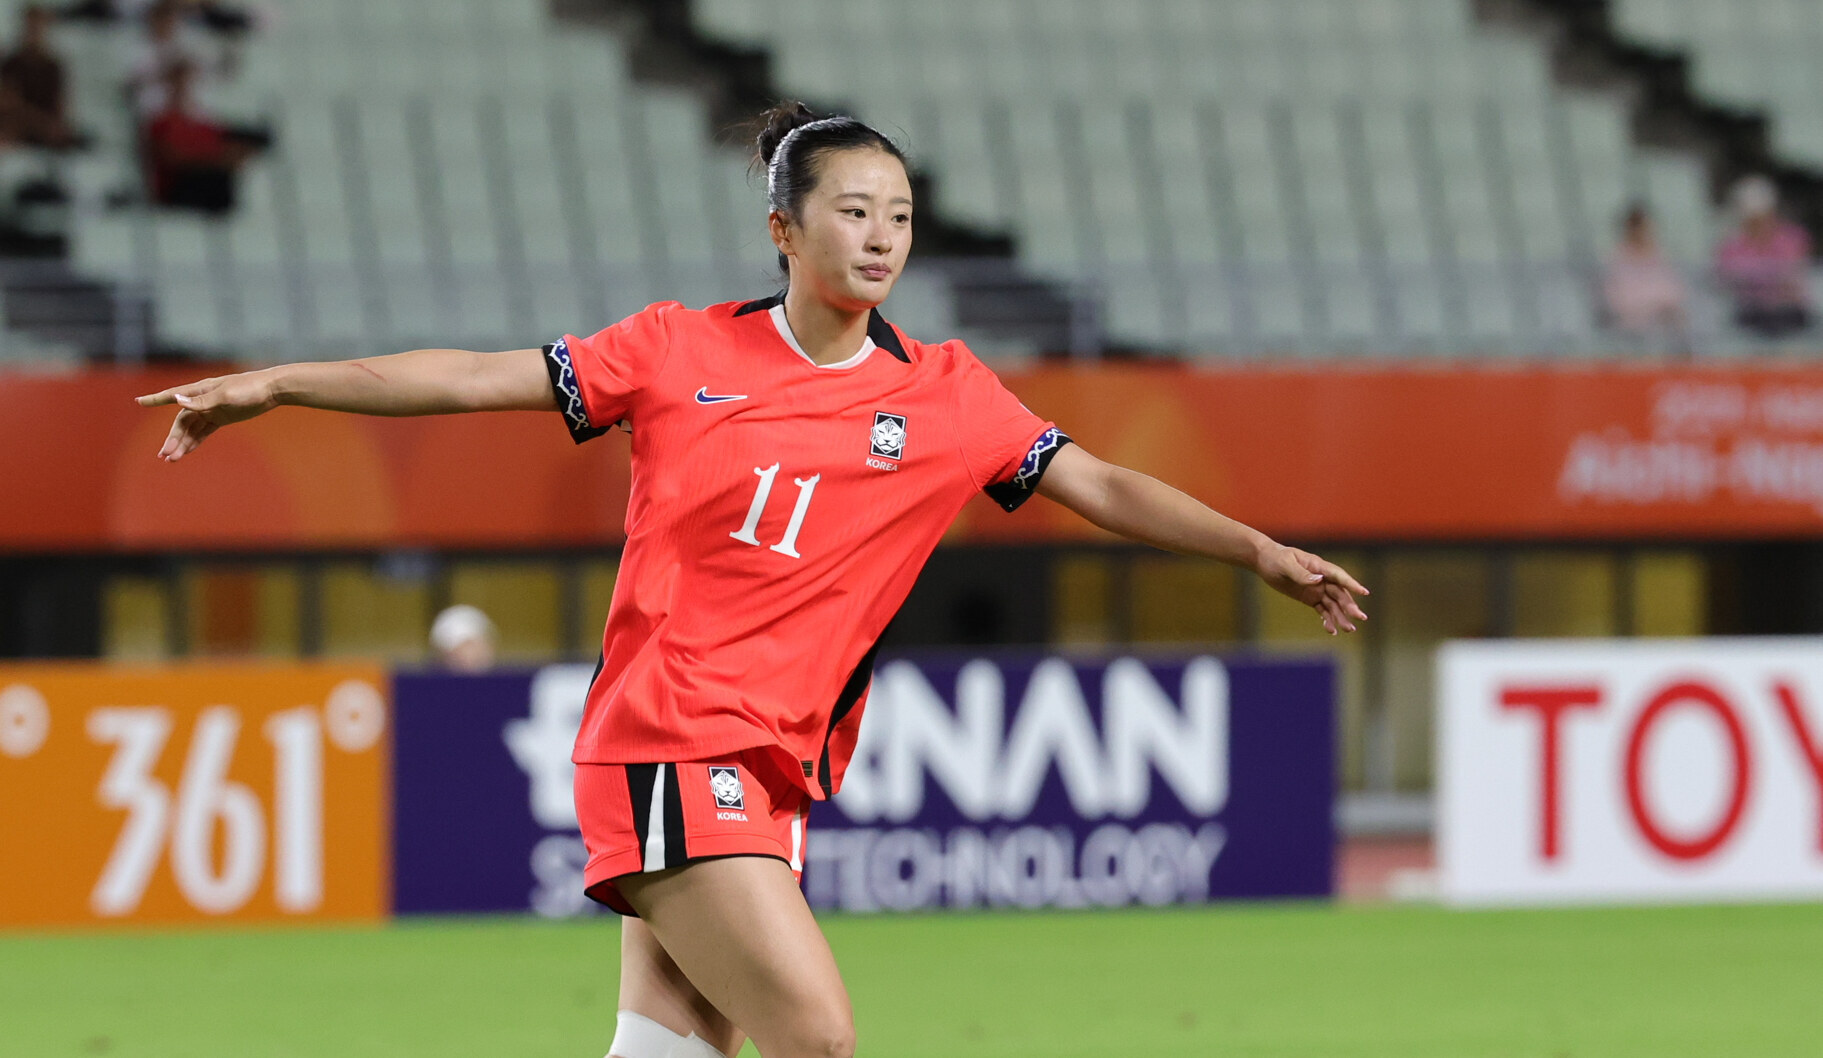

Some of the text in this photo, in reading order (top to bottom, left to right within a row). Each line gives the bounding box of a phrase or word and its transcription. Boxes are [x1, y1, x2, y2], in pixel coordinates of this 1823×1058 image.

[865, 456, 899, 472] KOREA
[729, 461, 821, 559] 11
[716, 811, 749, 823] KOREA
